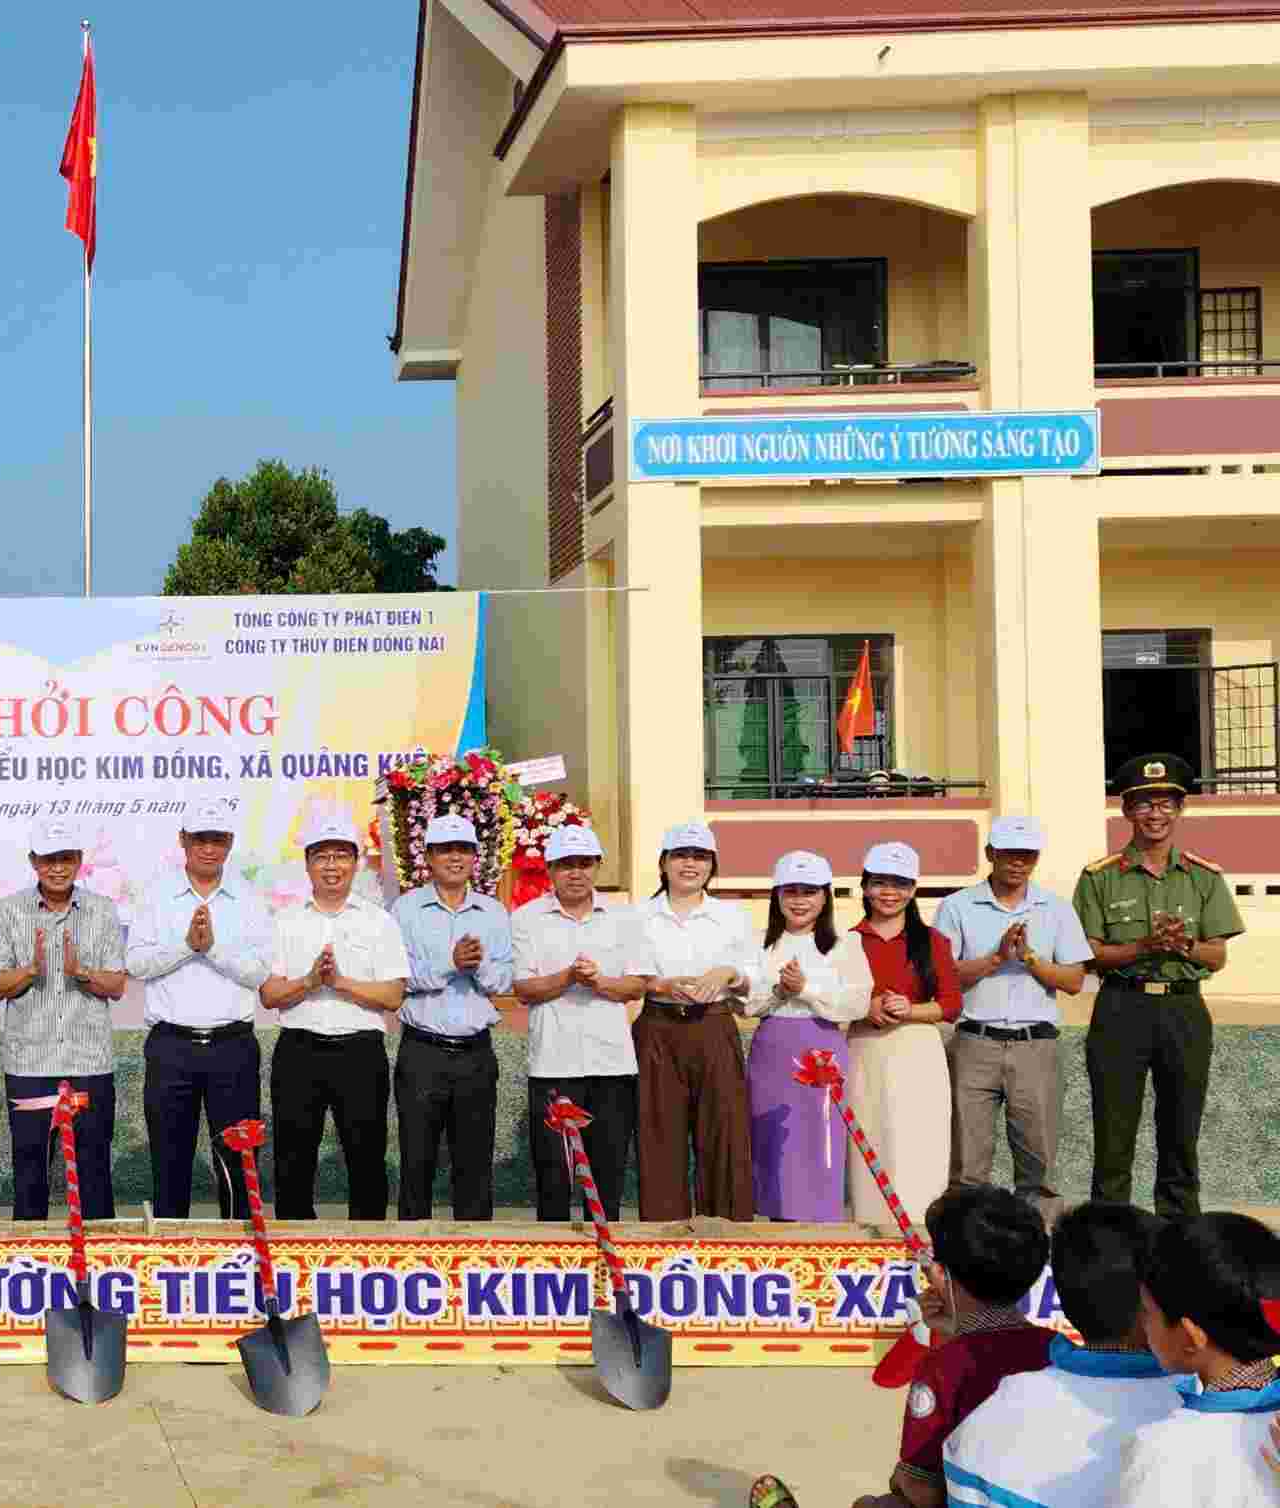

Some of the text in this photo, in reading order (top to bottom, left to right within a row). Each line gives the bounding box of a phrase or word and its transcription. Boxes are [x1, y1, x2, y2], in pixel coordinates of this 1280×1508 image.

[1040, 427, 1081, 464] TẠO
[322, 611, 341, 628] TY
[270, 638, 289, 655] TY
[419, 635, 445, 652] NAI
[113, 684, 280, 739] CÔNG
[37, 755, 86, 786] HỌC
[96, 755, 144, 780] KIM
[240, 749, 273, 779] XÃ
[47, 799, 71, 815] 13
[130, 799, 145, 814] 5
[158, 1253, 291, 1314] TIỂU
[317, 1270, 443, 1328] HỌC
[466, 1271, 589, 1317] KIM
[836, 1265, 917, 1318] XÃ
